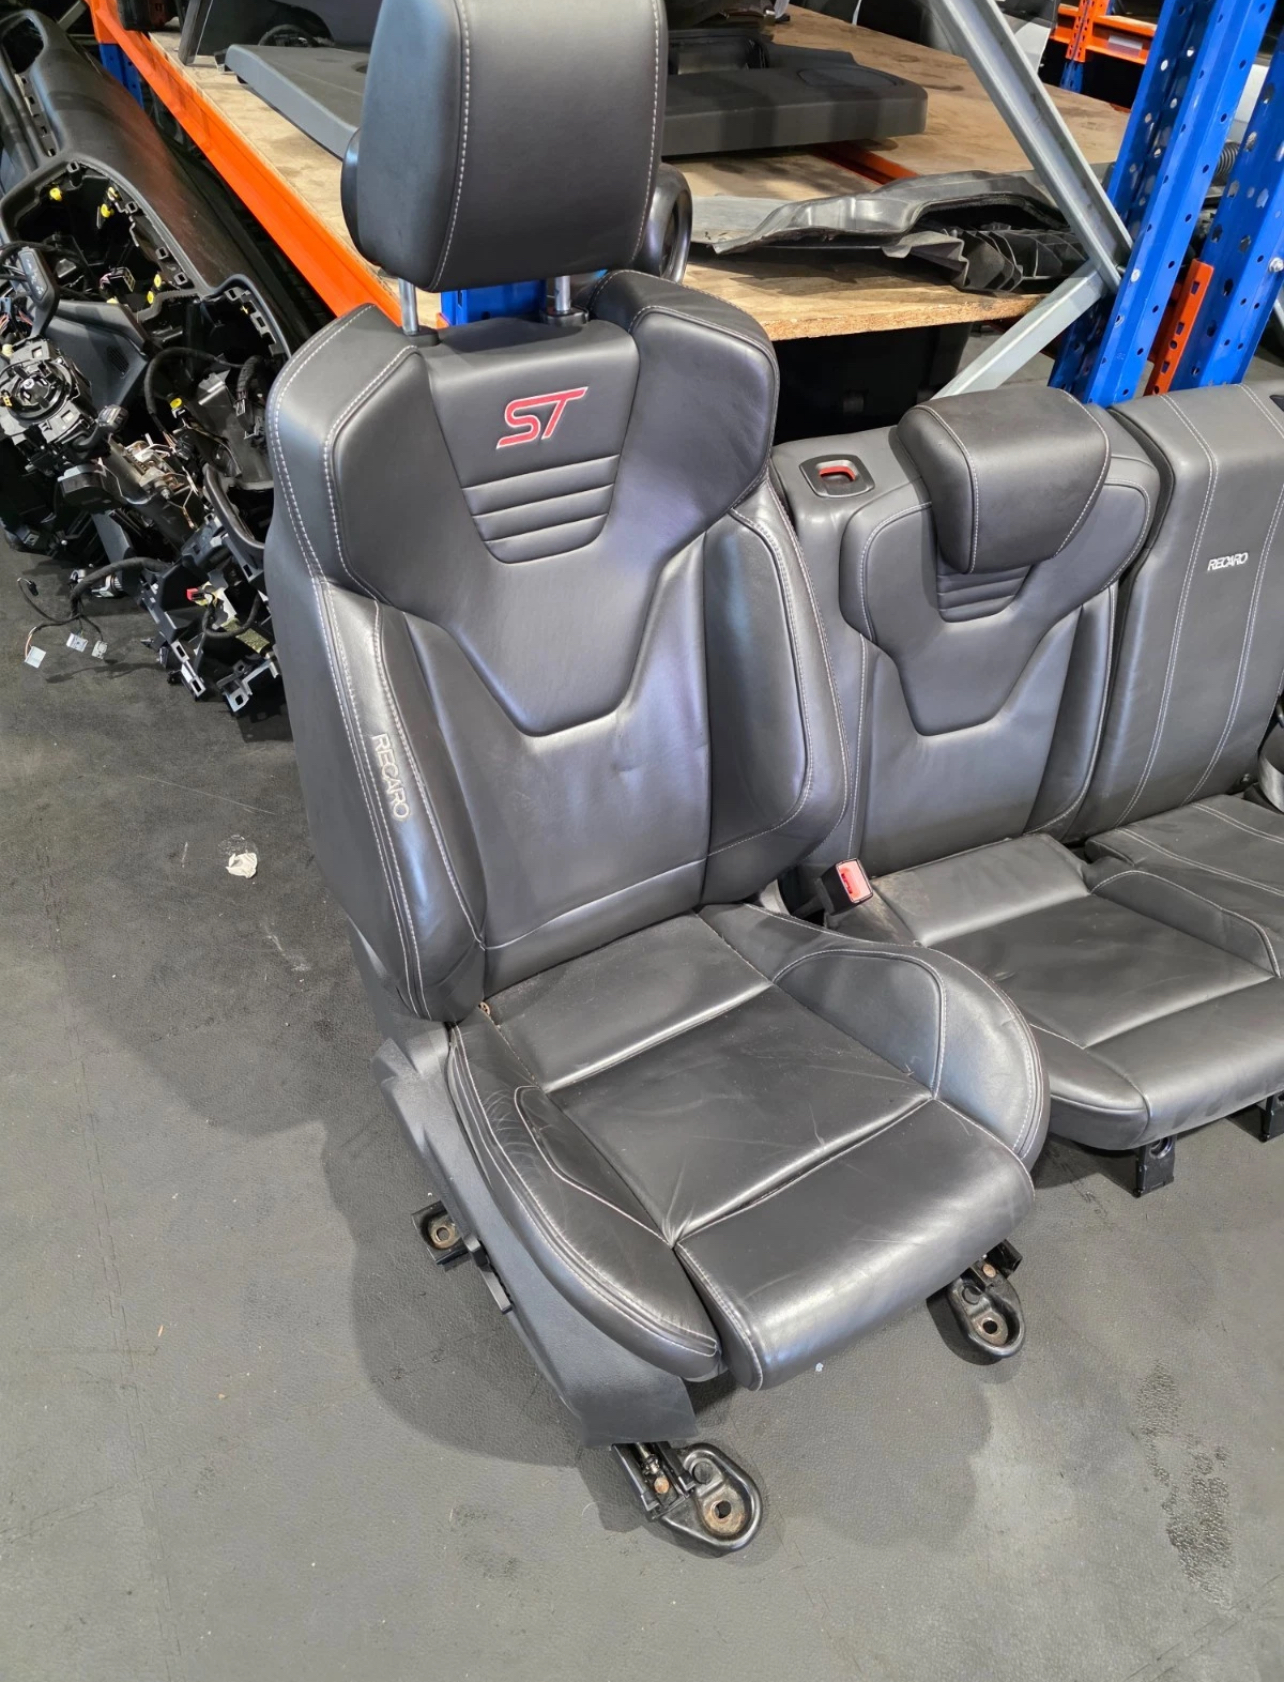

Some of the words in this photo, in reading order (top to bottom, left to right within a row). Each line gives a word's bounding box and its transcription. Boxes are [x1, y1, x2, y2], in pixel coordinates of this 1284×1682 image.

[495, 385, 589, 450] ST
[1207, 552, 1249, 572] RECARO
[371, 733, 410, 819] RECARO
